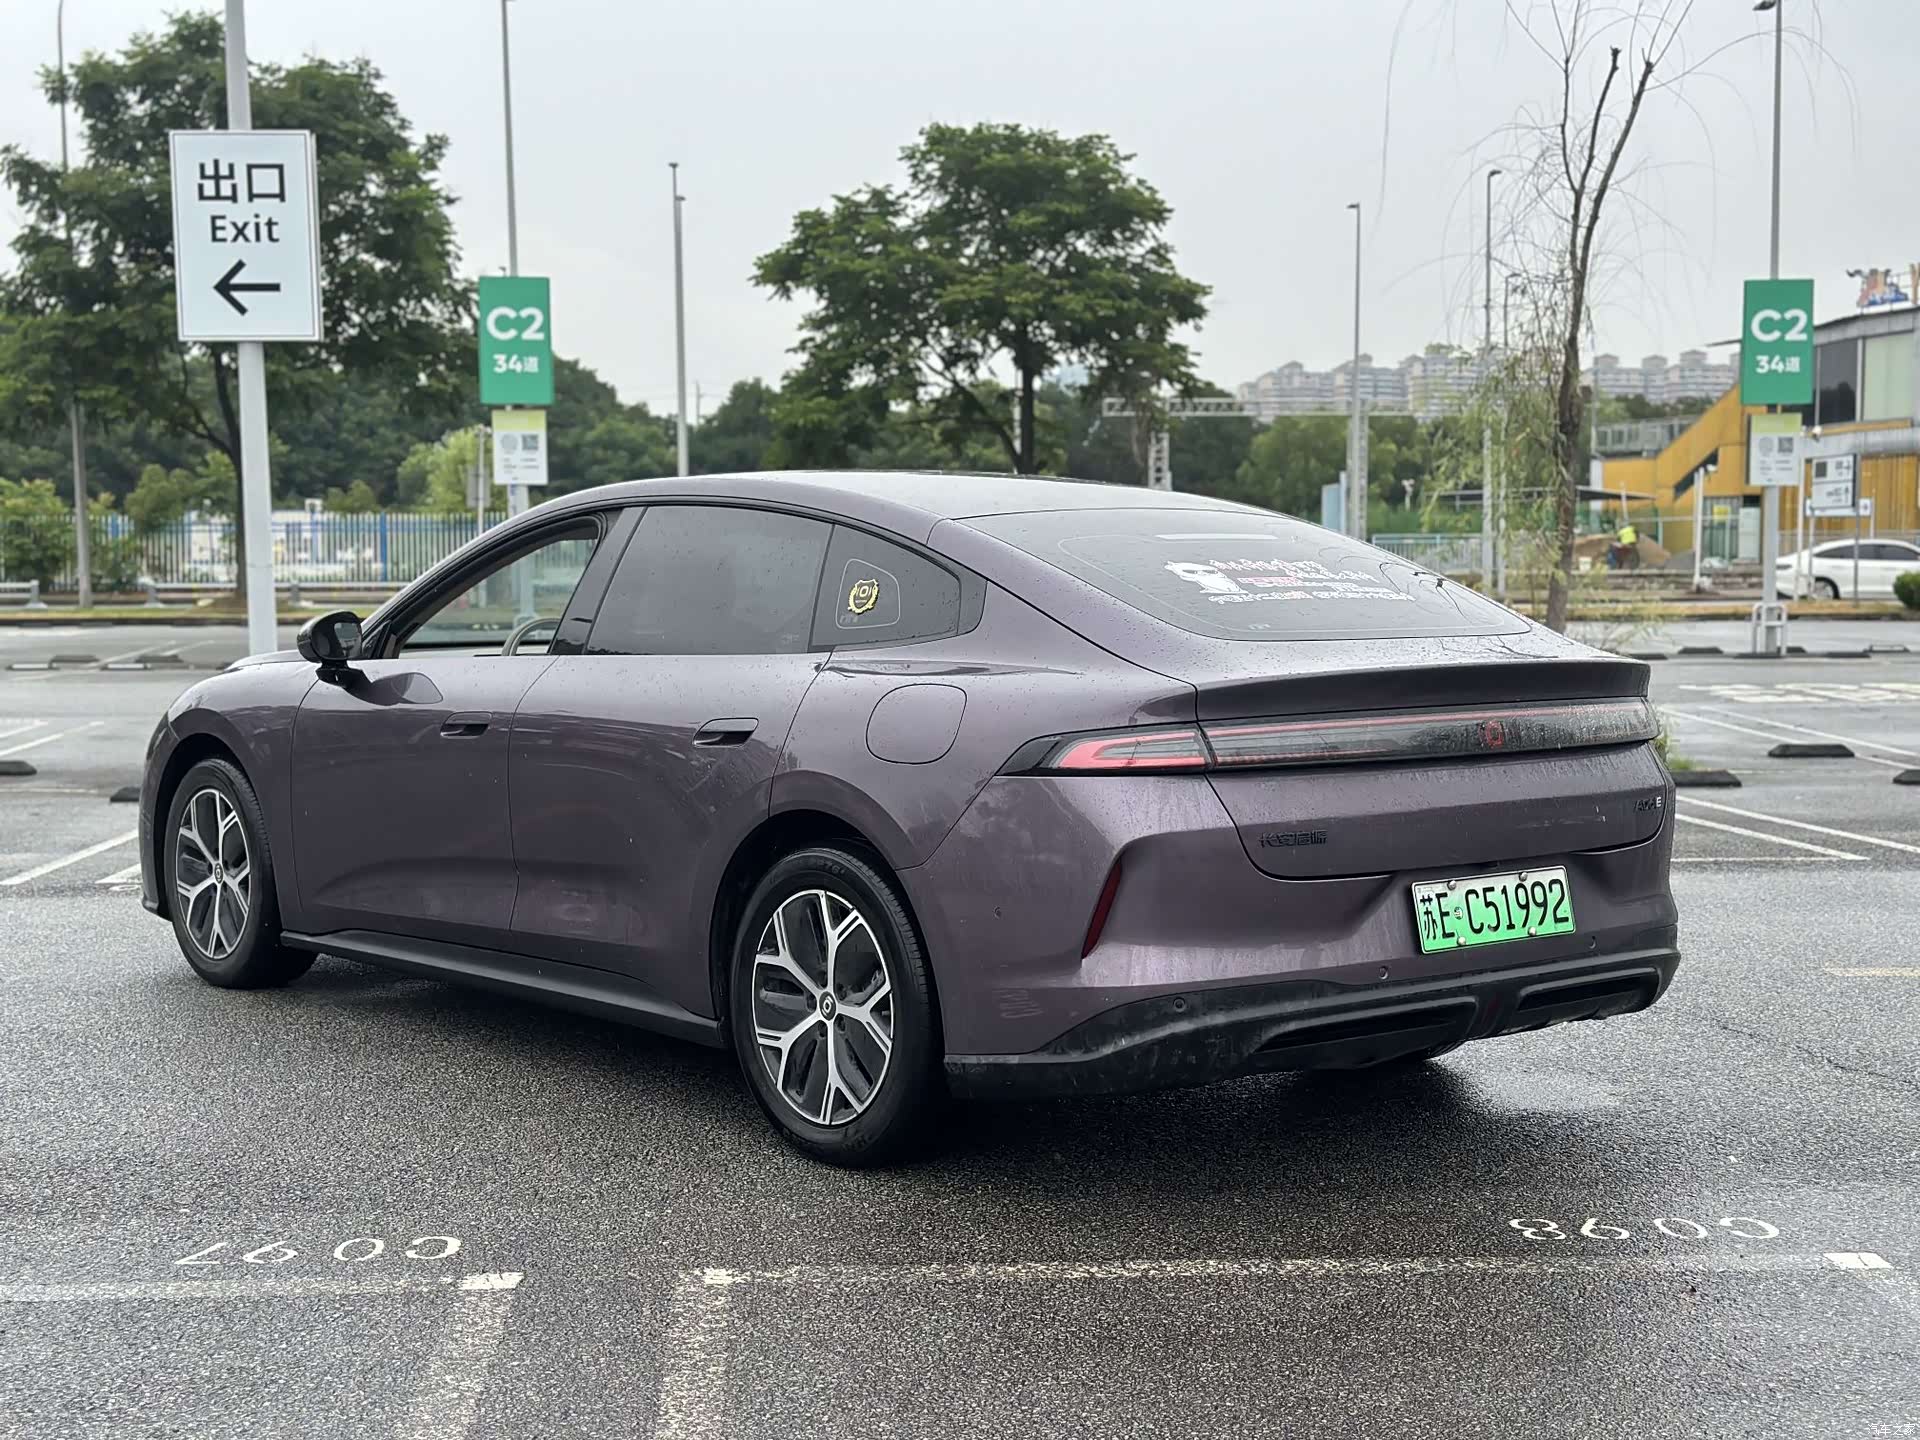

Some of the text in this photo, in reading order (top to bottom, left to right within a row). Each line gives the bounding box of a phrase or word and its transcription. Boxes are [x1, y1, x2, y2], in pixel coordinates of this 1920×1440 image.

[197, 158, 286, 203] 出口
[210, 213, 280, 243] Exit
[486, 306, 545, 340] C2
[1751, 308, 1808, 343] C2
